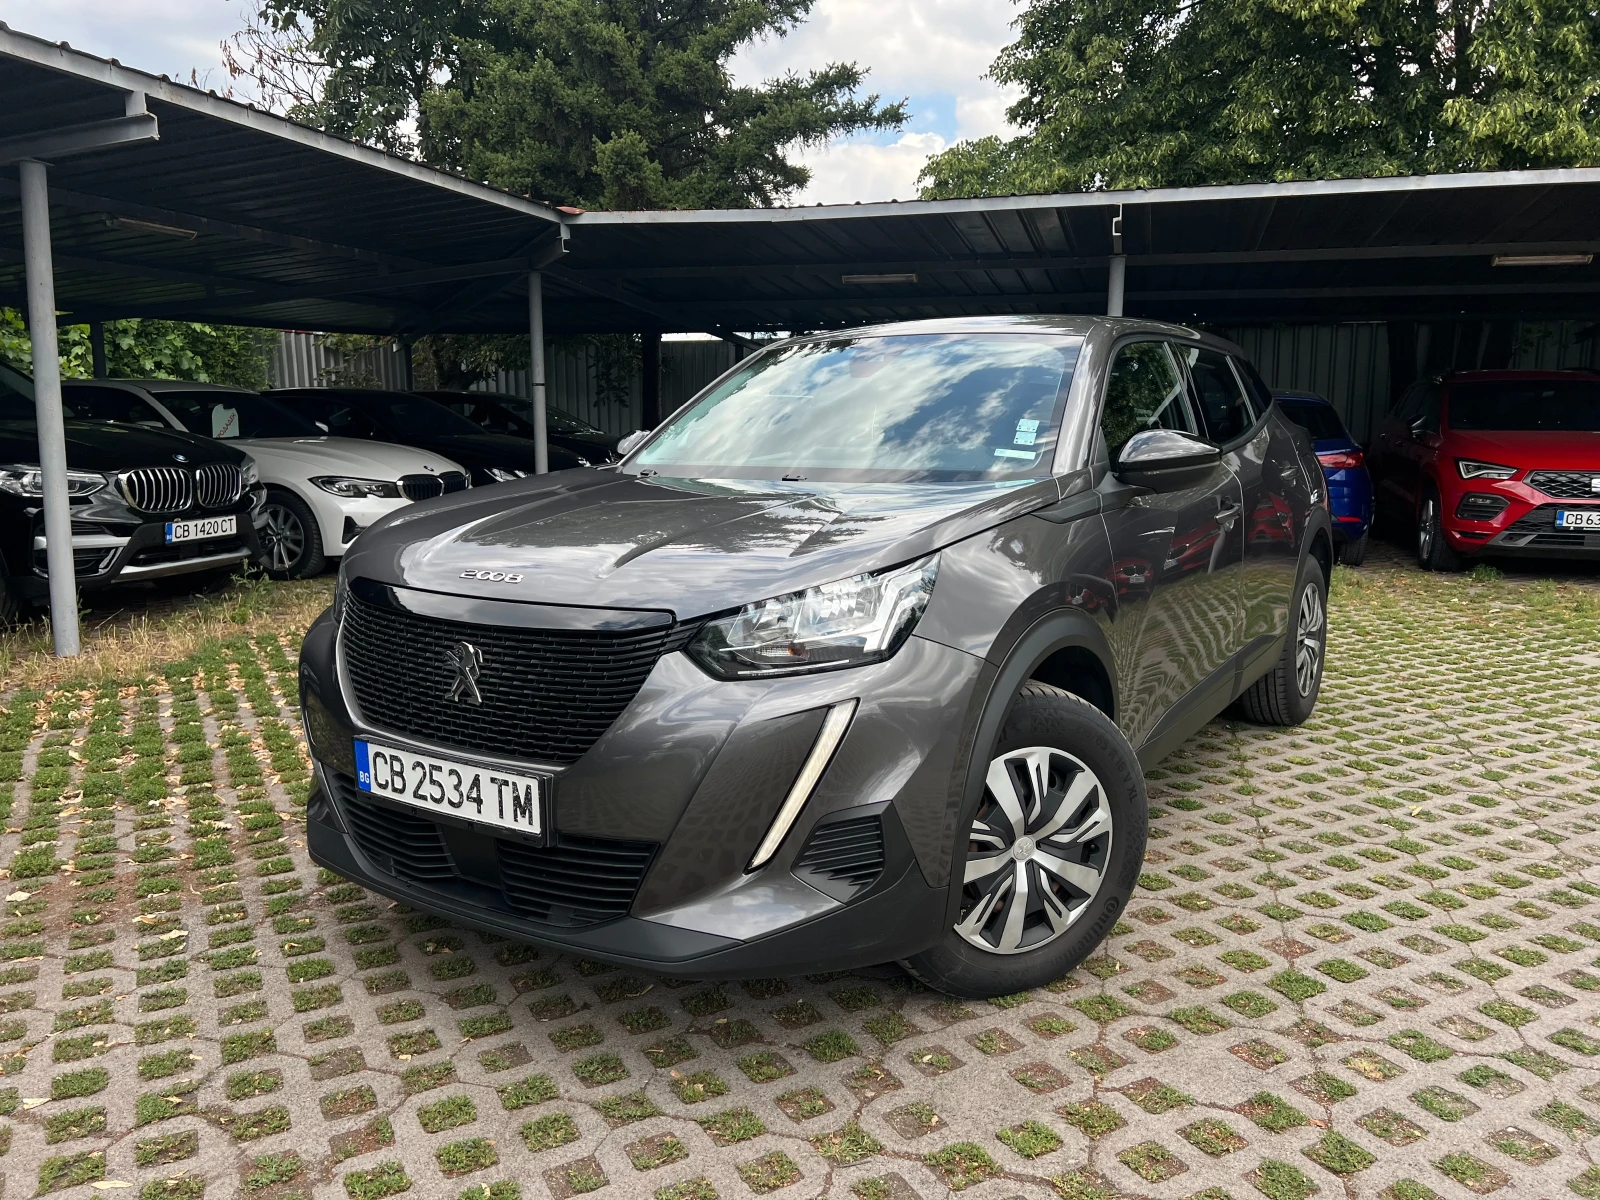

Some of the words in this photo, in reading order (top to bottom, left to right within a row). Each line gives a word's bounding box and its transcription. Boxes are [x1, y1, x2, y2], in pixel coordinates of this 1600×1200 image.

[1566, 513, 1583, 525] CB
[174, 524, 190, 539] CB
[194, 520, 219, 537] 1420
[221, 518, 234, 533] CT
[459, 569, 524, 584] 2008
[359, 770, 370, 784] BG
[372, 751, 407, 795] CB
[411, 760, 484, 814] 2534
[490, 776, 534, 826] TM
